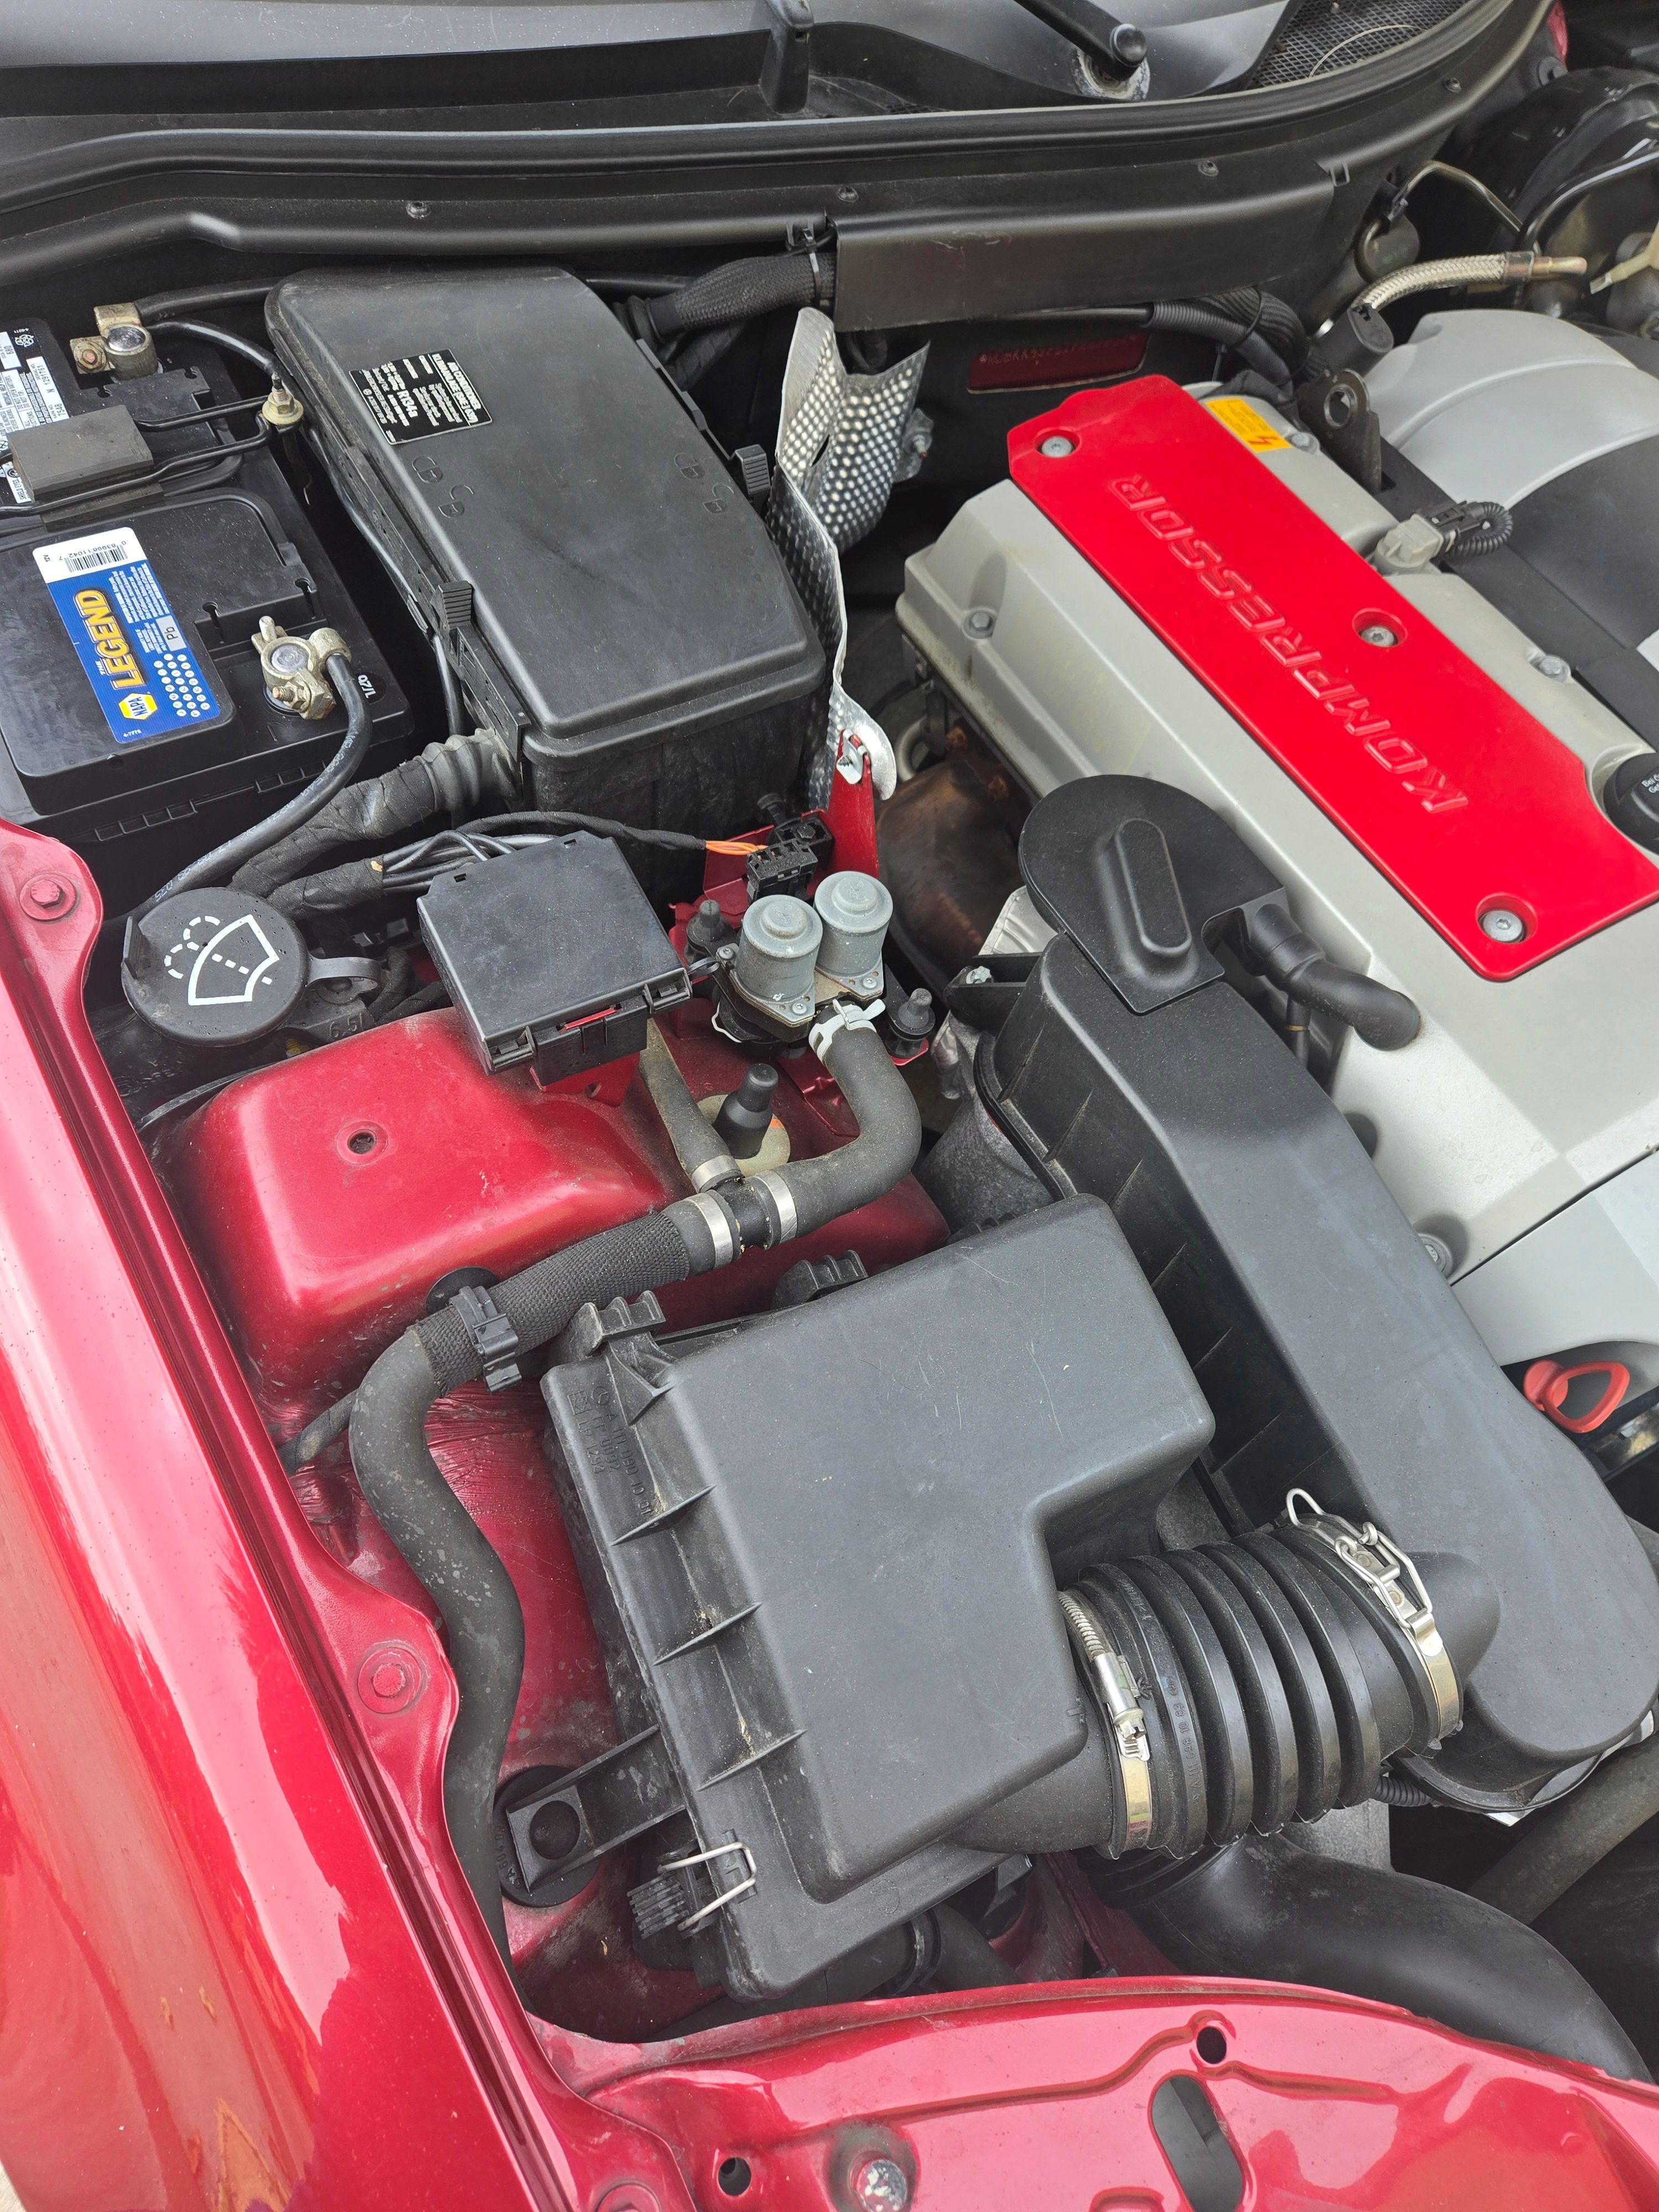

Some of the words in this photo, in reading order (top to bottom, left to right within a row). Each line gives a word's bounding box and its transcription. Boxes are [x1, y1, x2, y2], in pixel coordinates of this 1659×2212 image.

[3, 345, 14, 354] 680
[36, 364, 51, 385] 1291761
[54, 403, 66, 416] 7548
[397, 390, 419, 418] R134a
[74, 589, 145, 688] LEGEND
[165, 627, 178, 640] Pb
[1110, 475, 1468, 813] KOMPRESSOR
[94, 659, 106, 675] THE
[129, 697, 148, 716] NAPA
